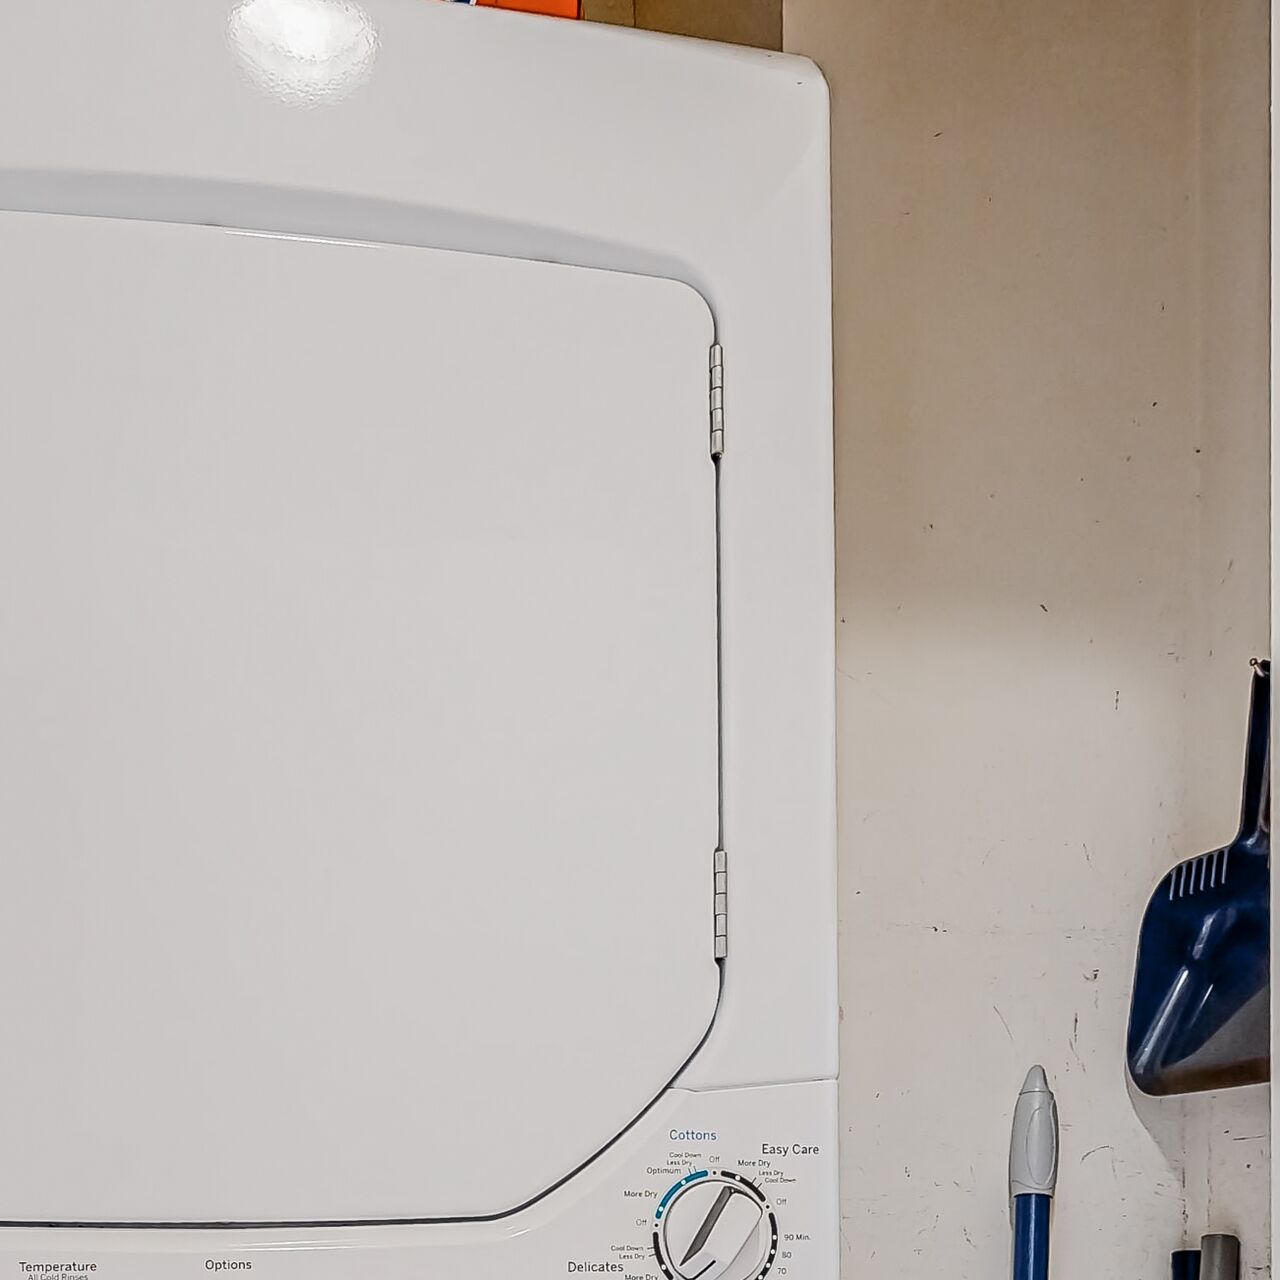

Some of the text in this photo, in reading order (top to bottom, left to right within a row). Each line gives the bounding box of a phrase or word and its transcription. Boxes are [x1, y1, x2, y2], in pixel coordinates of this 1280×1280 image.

[669, 1130, 717, 1140] Cottons
[762, 1144, 820, 1156] Easy Care
[758, 1160, 771, 1168] Dry
[647, 1167, 682, 1175] Optimum
[645, 1191, 658, 1199] Dry
[19, 1261, 97, 1274] Temperature
[205, 1260, 252, 1272] Options
[568, 1261, 624, 1272] Delicates
[62, 1273, 89, 1280] Rinses
